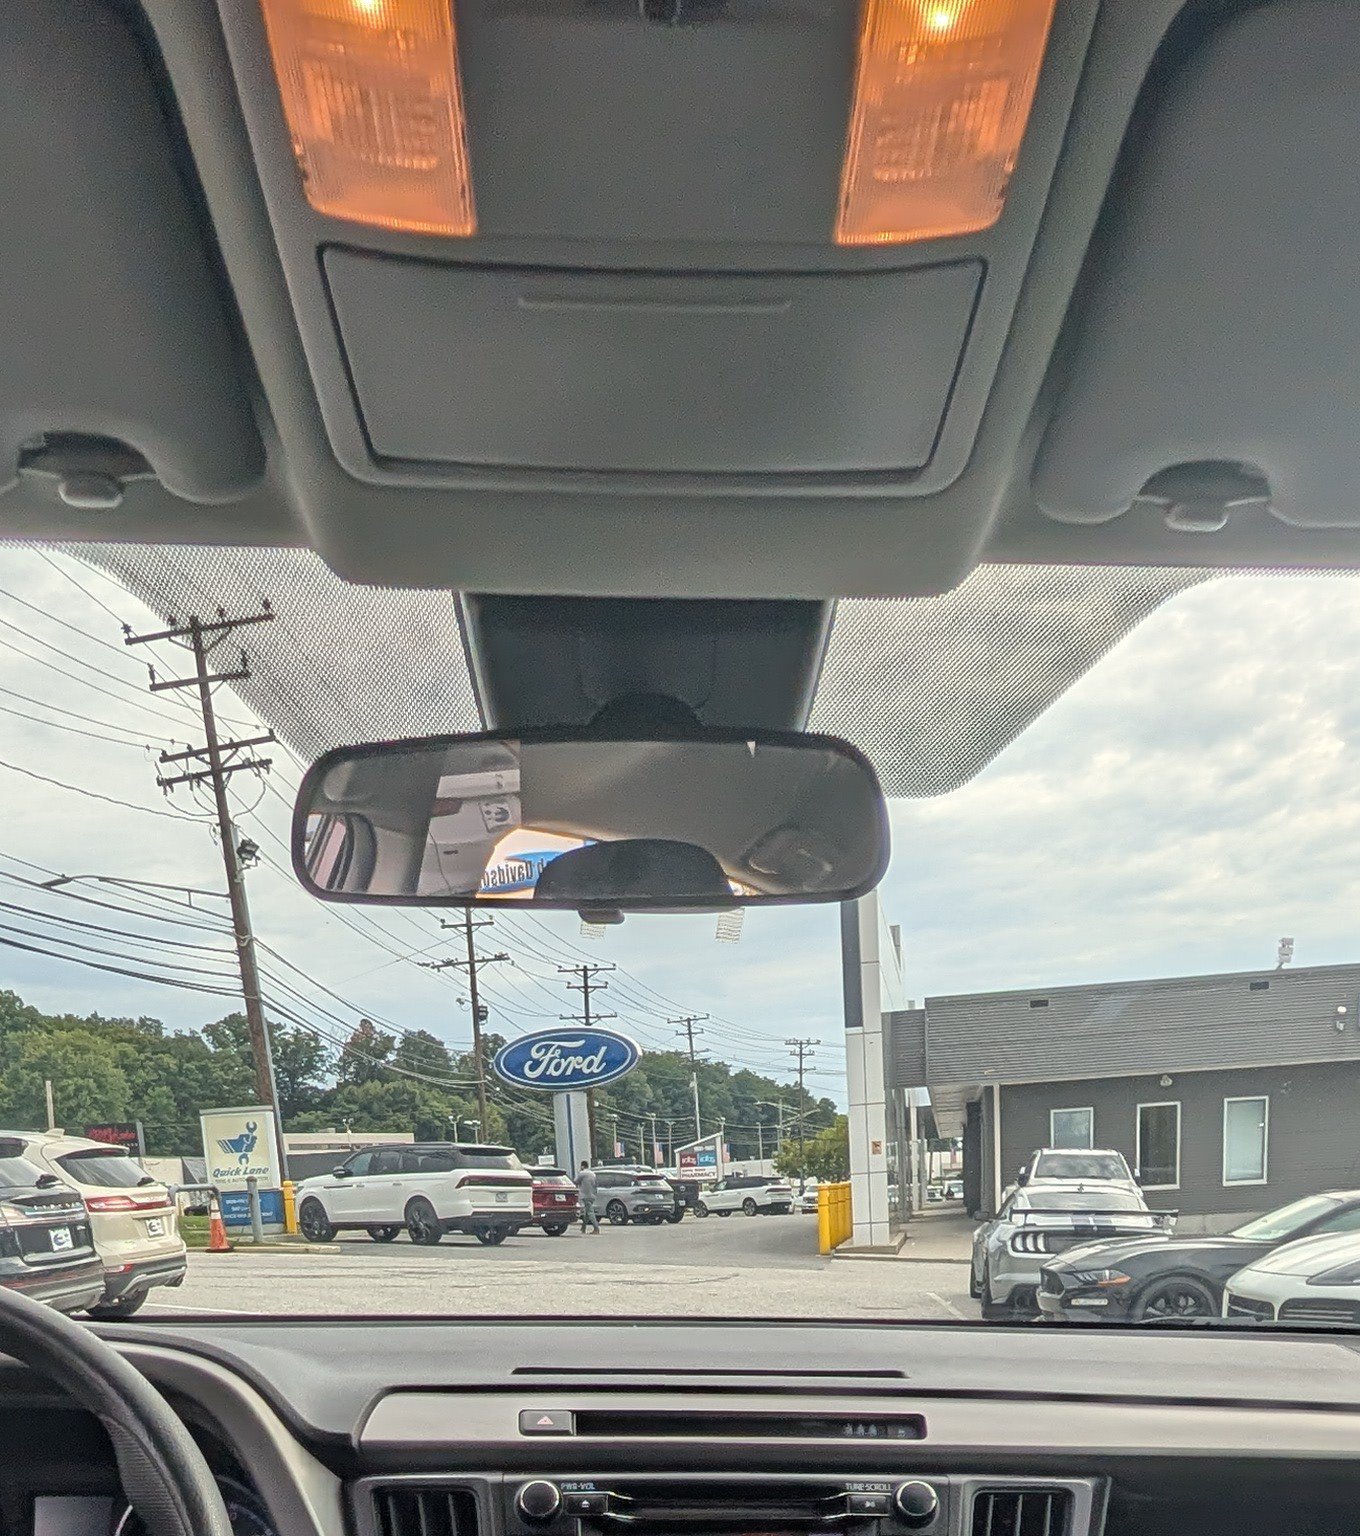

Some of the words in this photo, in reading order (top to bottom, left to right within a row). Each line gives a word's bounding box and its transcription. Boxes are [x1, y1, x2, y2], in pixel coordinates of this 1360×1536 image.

[523, 1039, 607, 1079] Ford
[213, 1167, 241, 1178] Quick
[243, 1167, 269, 1176] Lane
